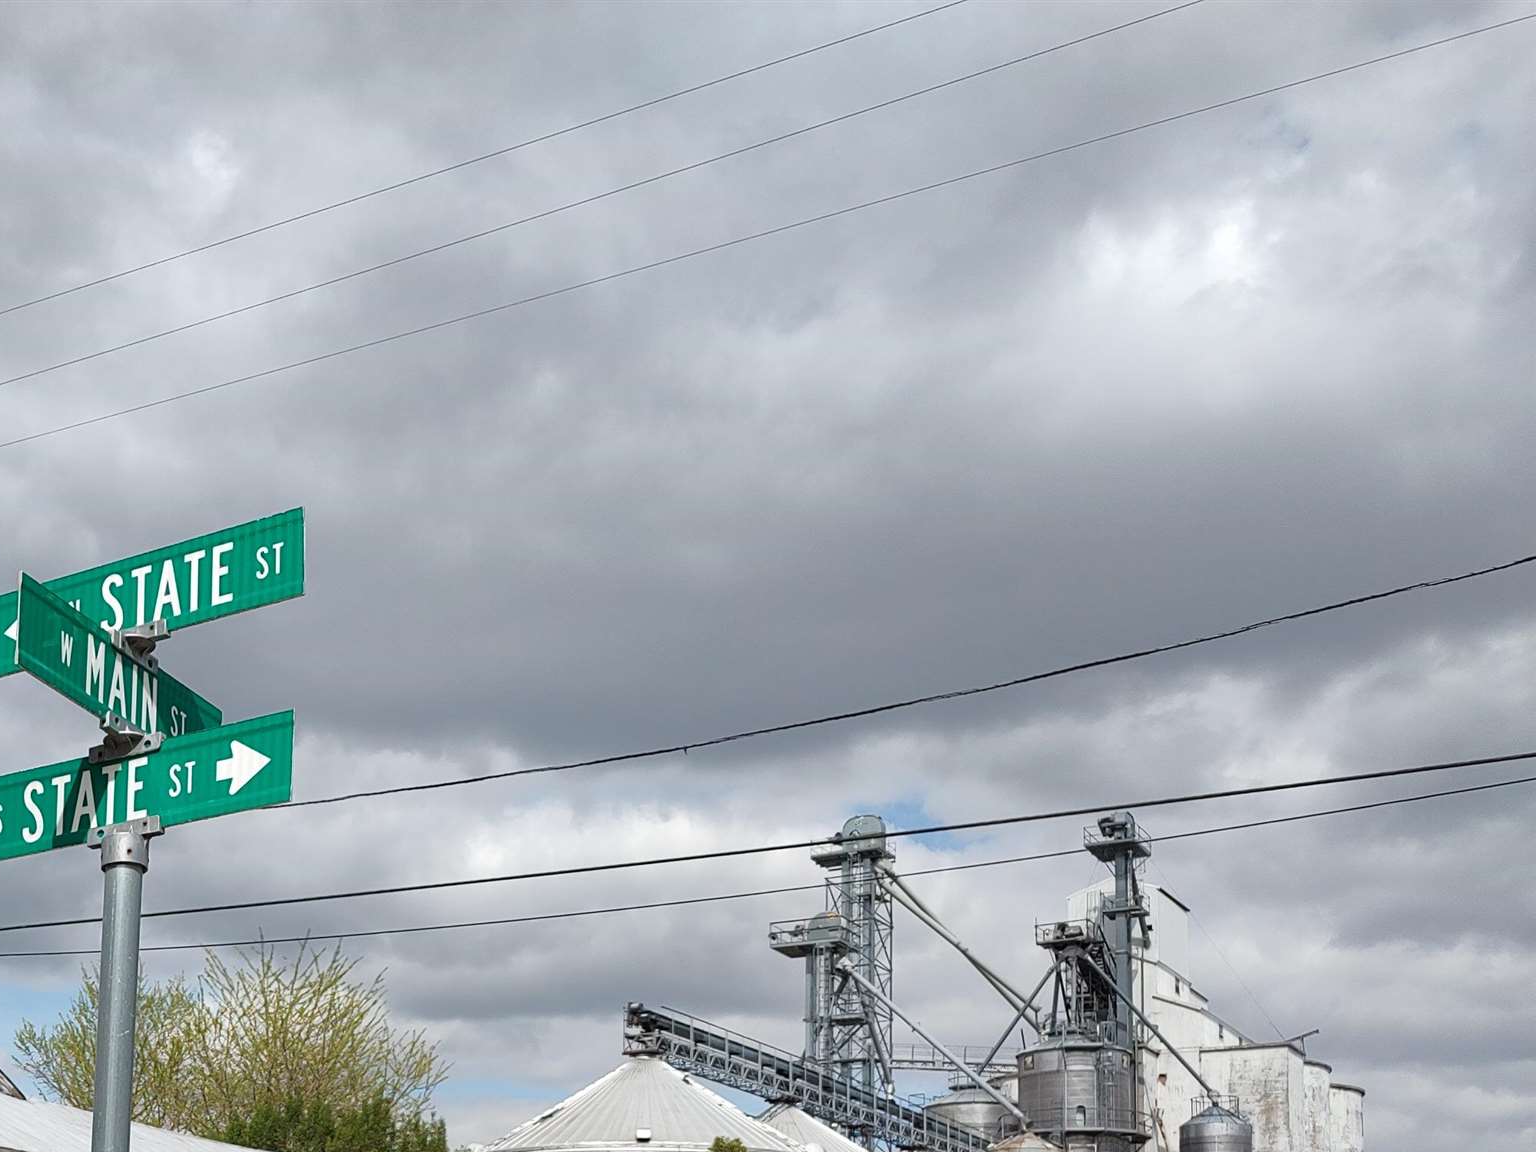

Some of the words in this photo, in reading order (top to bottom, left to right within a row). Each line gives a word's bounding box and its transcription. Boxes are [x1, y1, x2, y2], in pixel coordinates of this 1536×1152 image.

[100, 542, 233, 632] STATE
[256, 542, 284, 580] ST
[61, 630, 73, 668] W
[85, 632, 158, 735] MAIN
[170, 705, 187, 737] ST
[21, 757, 149, 843] STATE
[168, 761, 196, 798] ST
